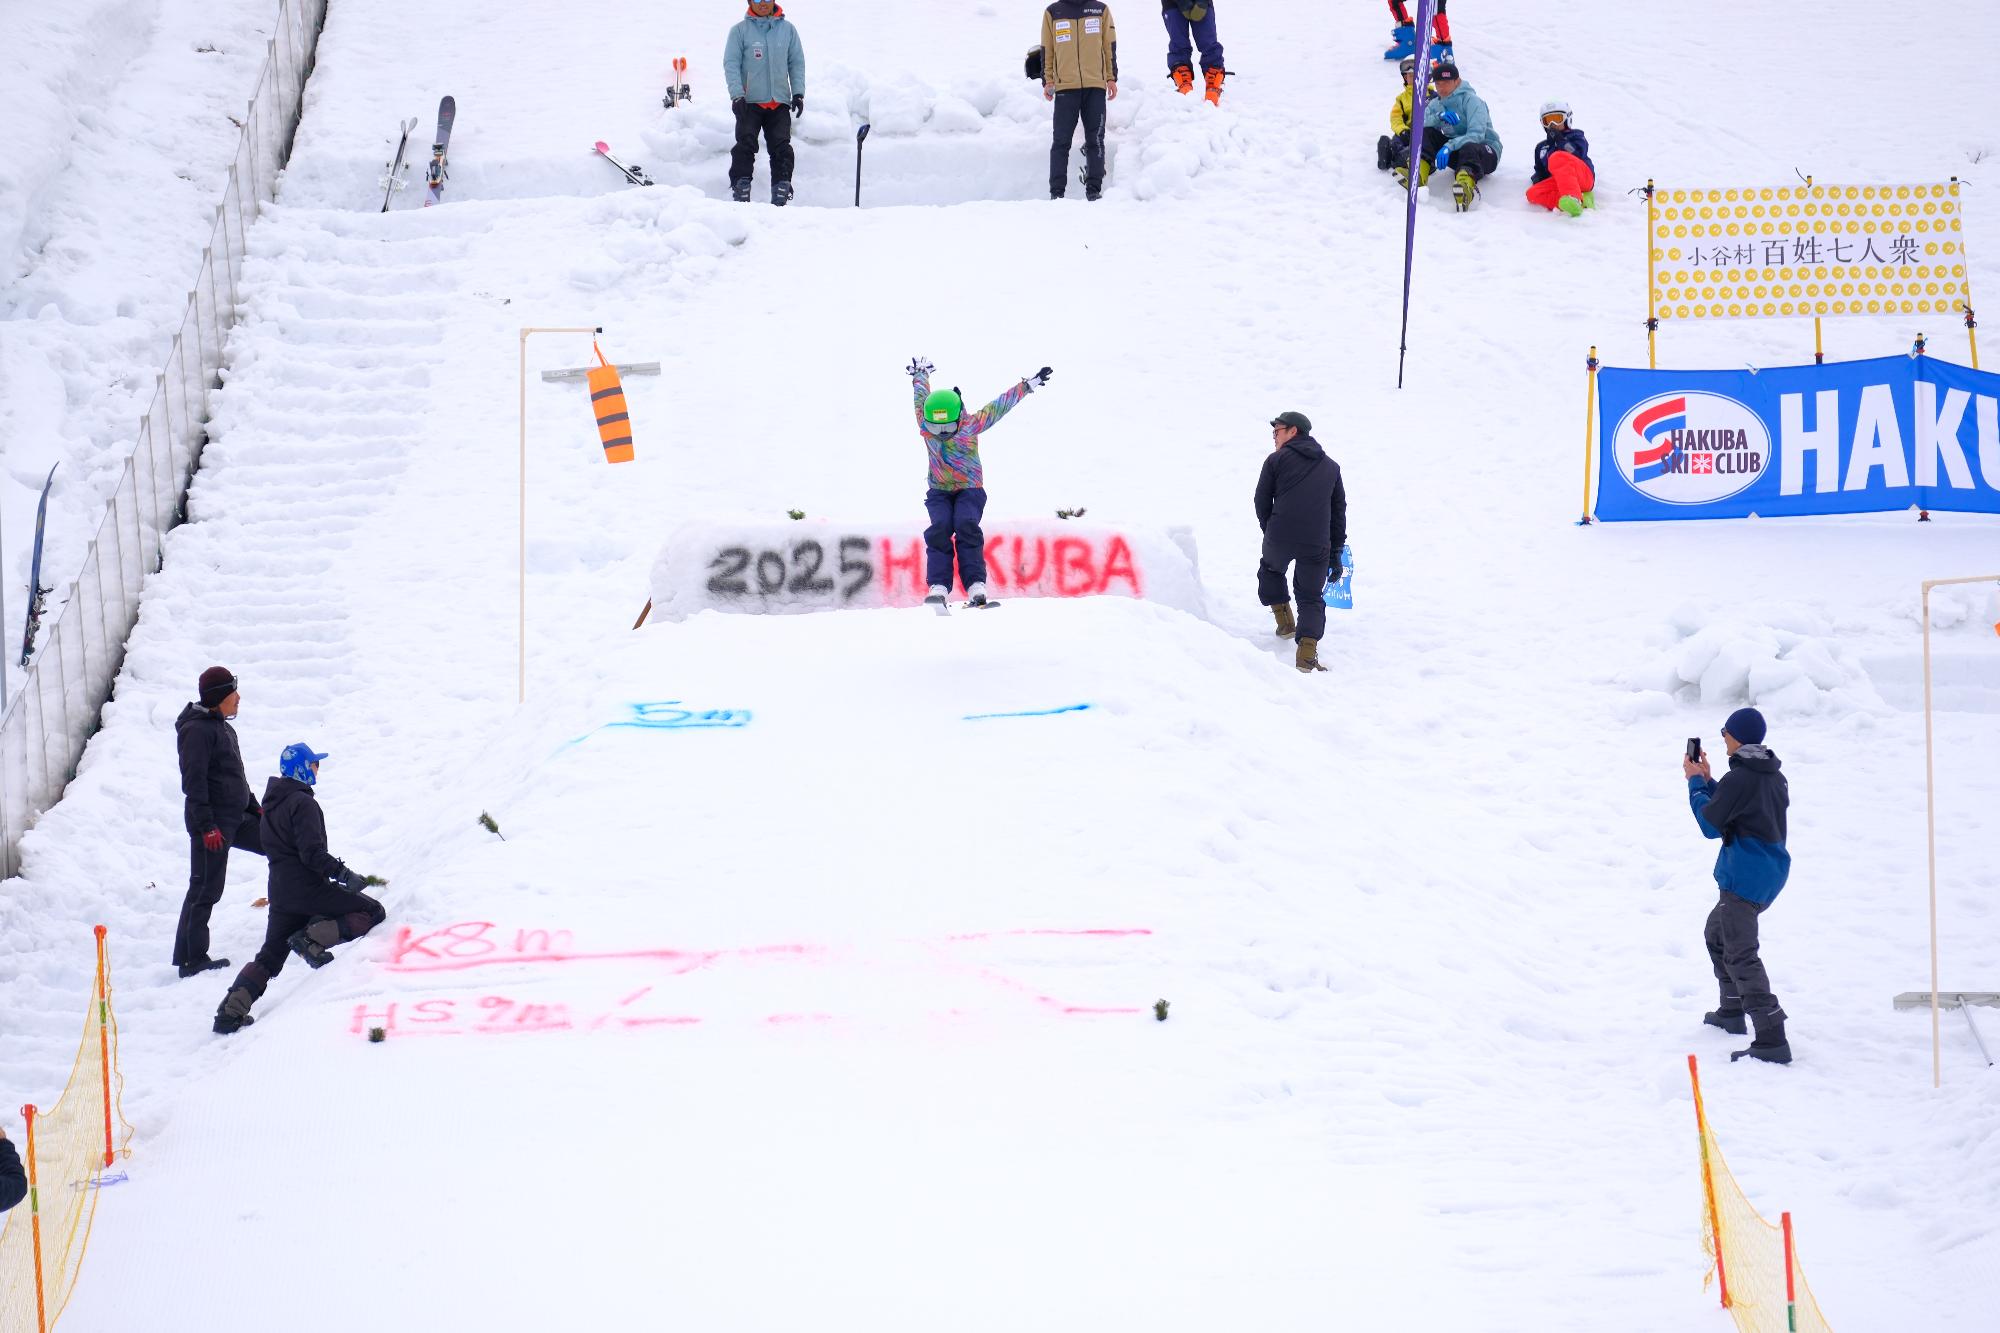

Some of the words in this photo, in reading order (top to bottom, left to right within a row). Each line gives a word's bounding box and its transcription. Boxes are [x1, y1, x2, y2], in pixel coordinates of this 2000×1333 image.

[1671, 428, 1749, 451] HAKUBA
[1660, 452, 1689, 475] SKI
[1715, 452, 1761, 474] CLUB
[880, 534, 1143, 600] HKUBA
